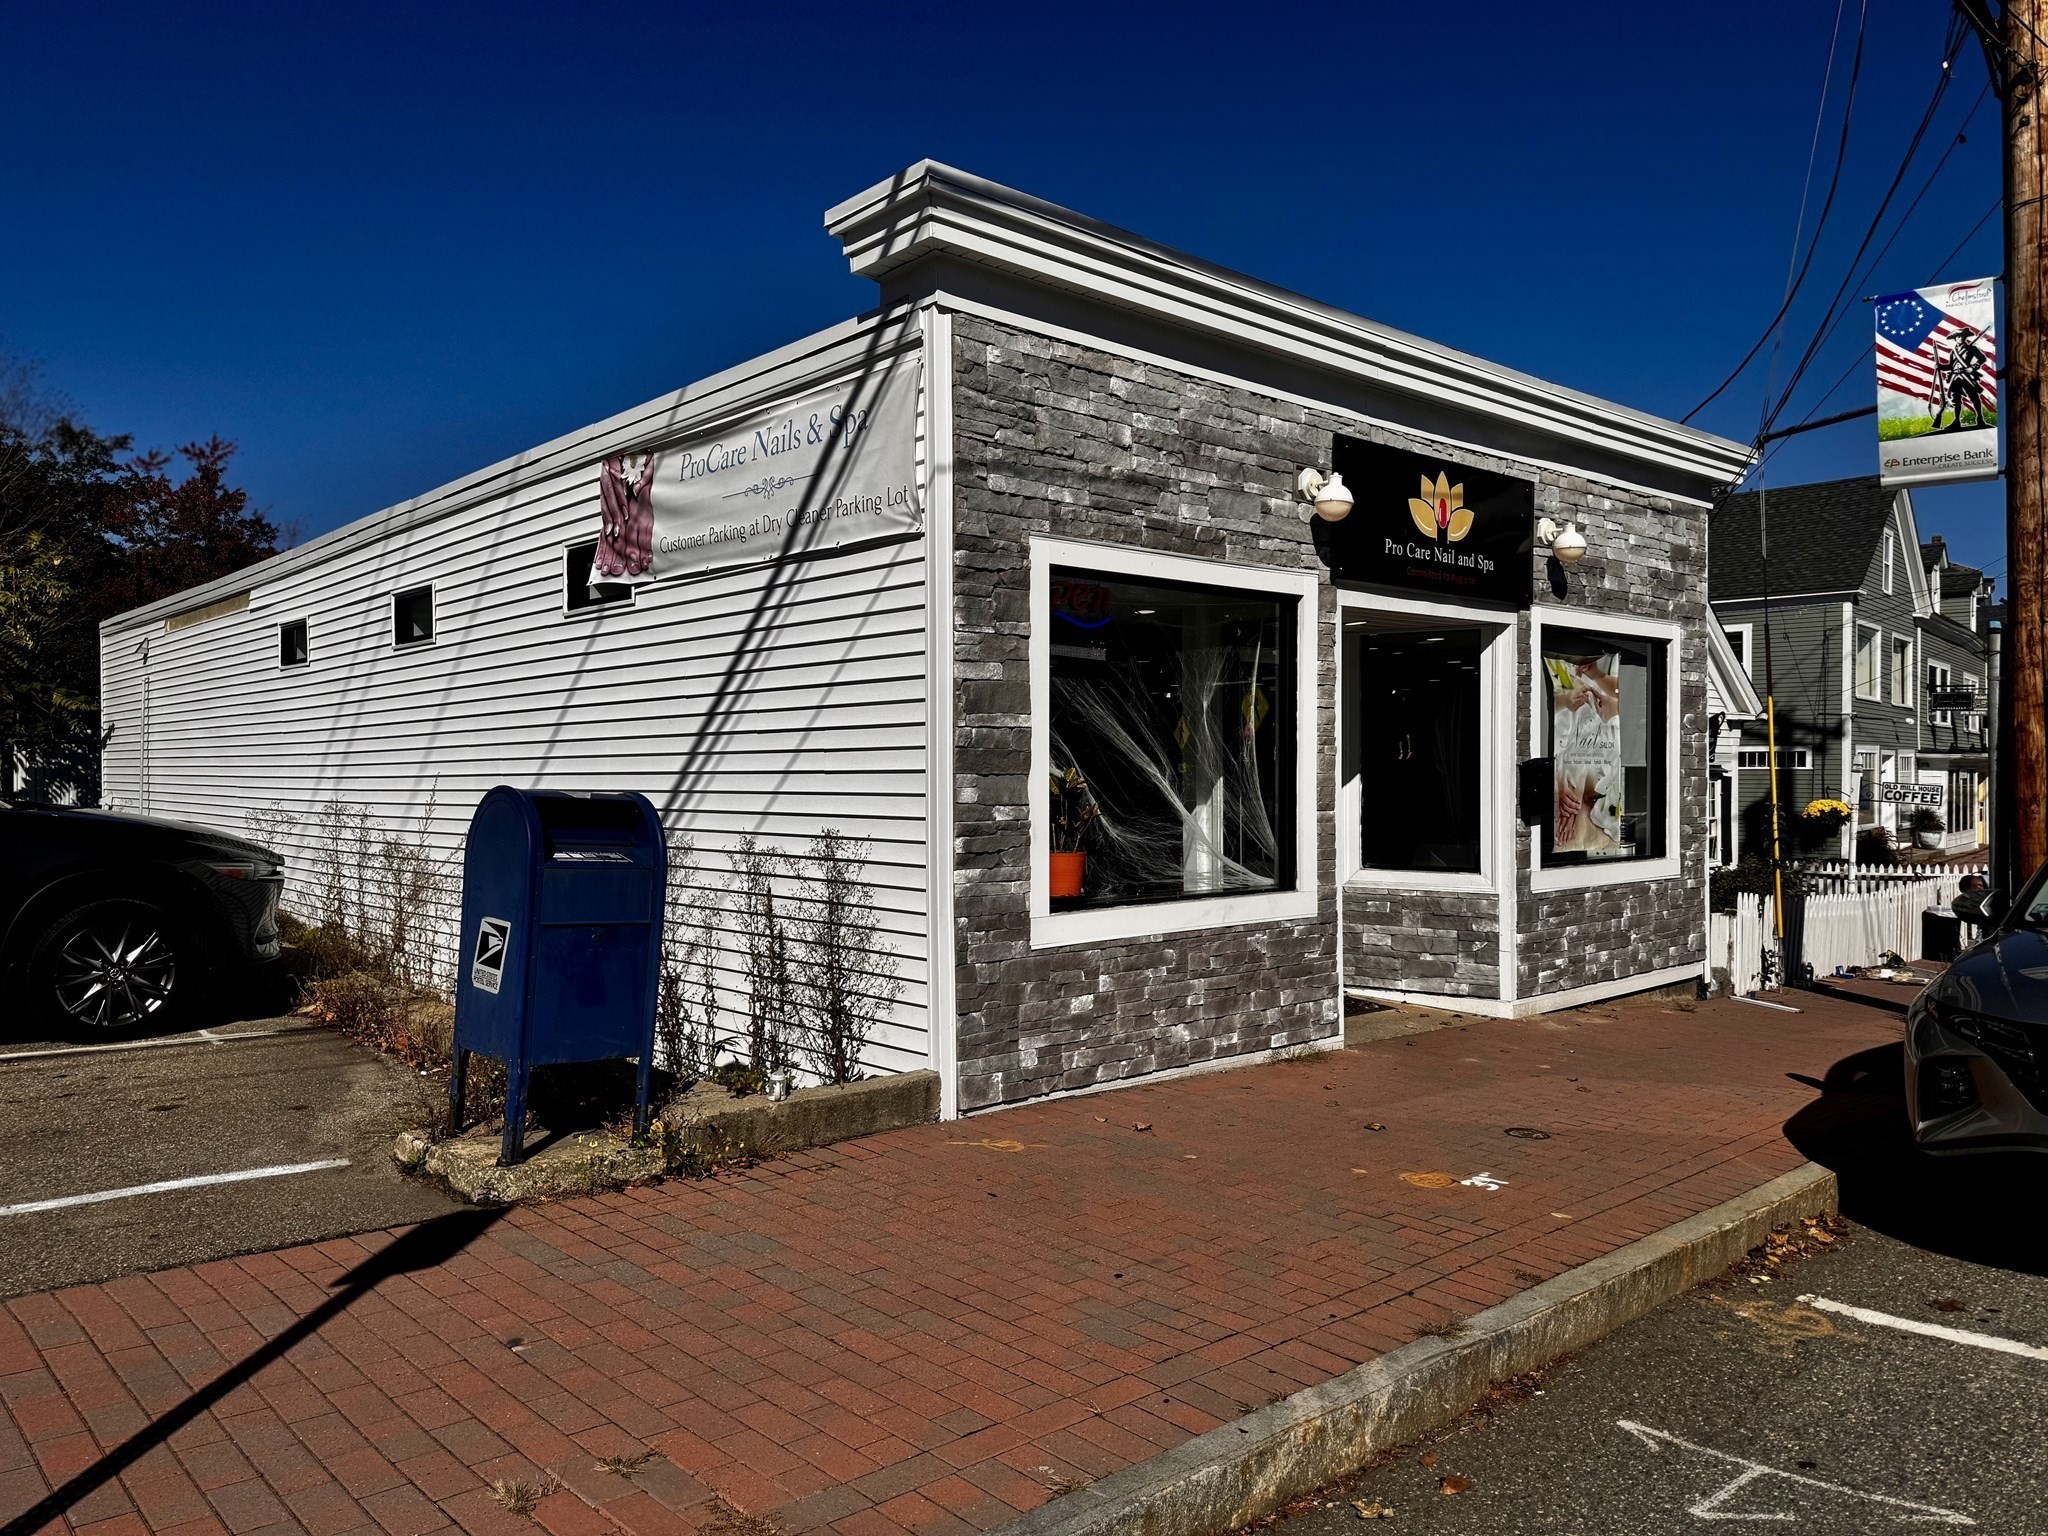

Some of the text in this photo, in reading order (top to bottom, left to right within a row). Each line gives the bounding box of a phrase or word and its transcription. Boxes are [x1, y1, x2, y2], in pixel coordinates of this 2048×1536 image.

[679, 403, 868, 482] ProCare Nails & Spa
[1902, 453, 1961, 467] Enterprise
[1963, 448, 1993, 460] Bank
[659, 484, 909, 554] Customer Parking at Dry Cleaner Parking Lot
[1385, 538, 1495, 573] Pro Care Nail and Spa
[1884, 790, 1940, 804] COFFEE
